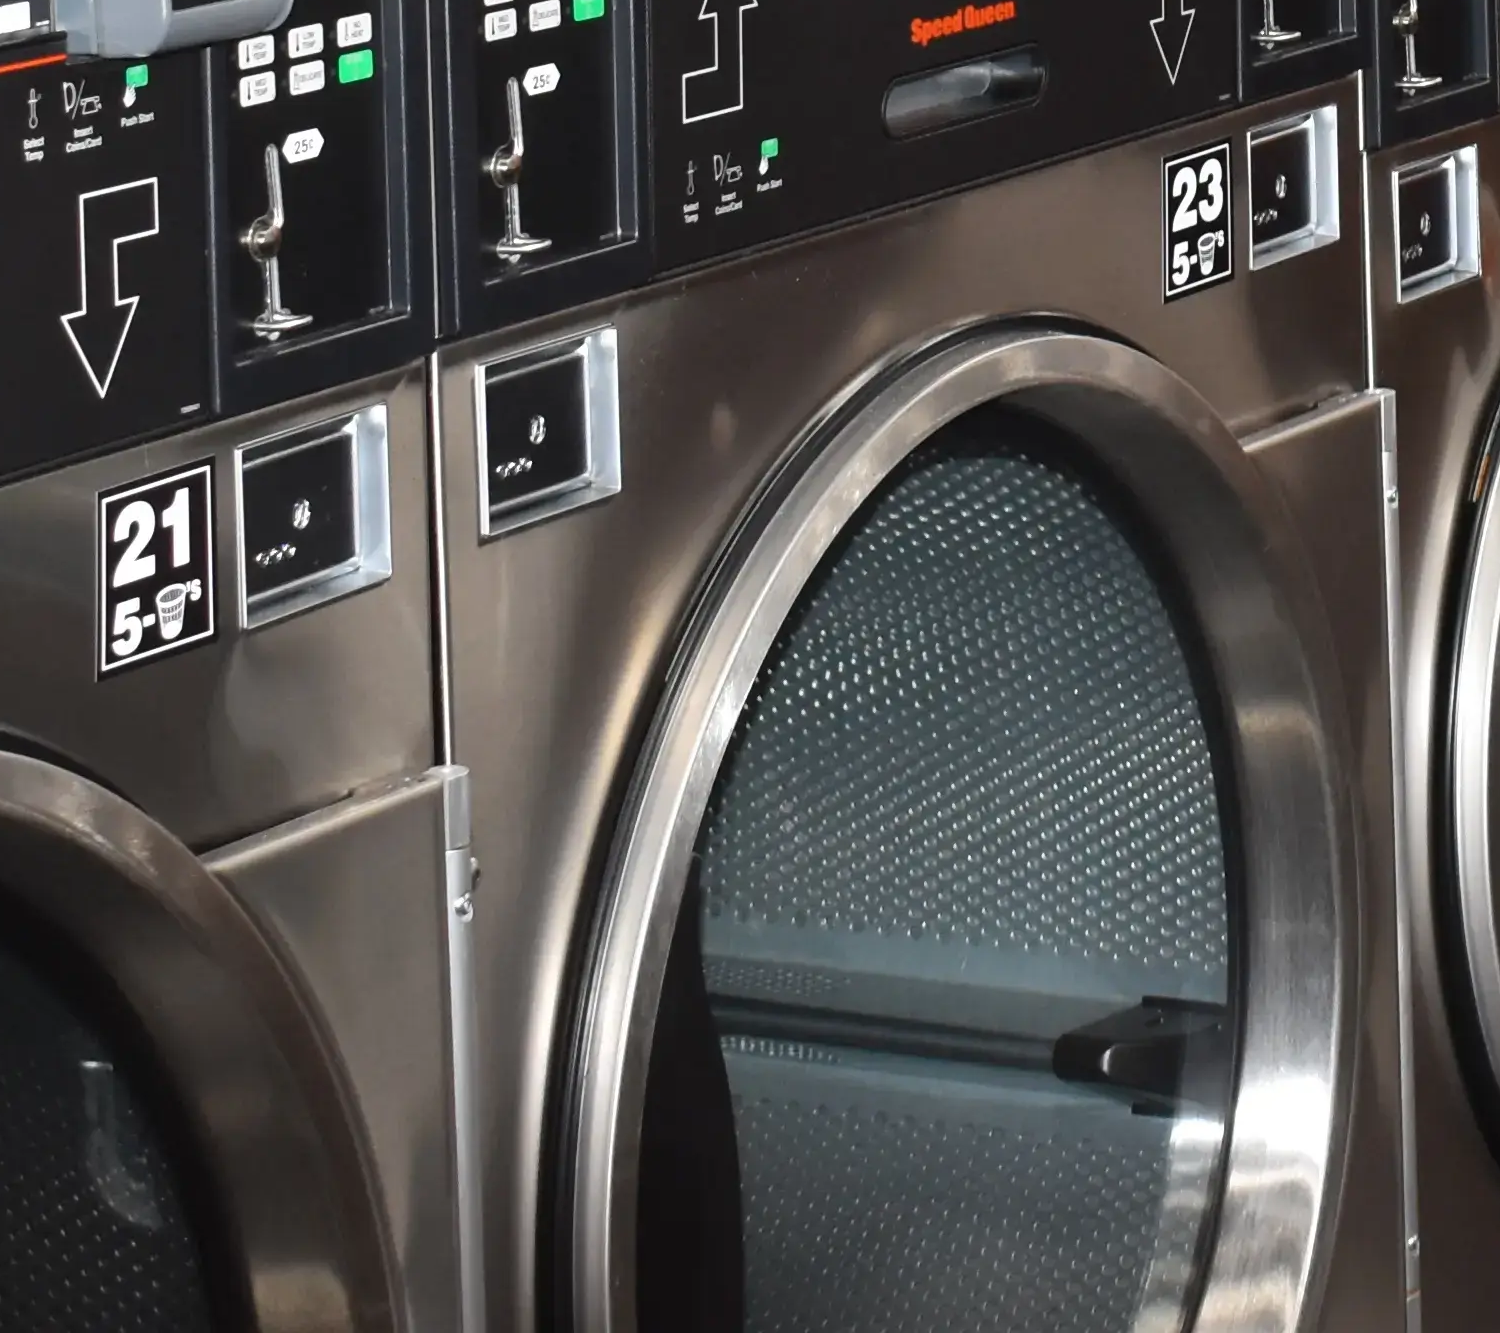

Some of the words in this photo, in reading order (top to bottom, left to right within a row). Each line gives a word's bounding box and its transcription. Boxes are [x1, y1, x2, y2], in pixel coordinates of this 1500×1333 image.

[911, 9, 962, 47] Speed
[964, 0, 1015, 28] Queen
[294, 137, 314, 155] 25¢
[1172, 158, 1224, 233] 23
[113, 487, 190, 588] 21
